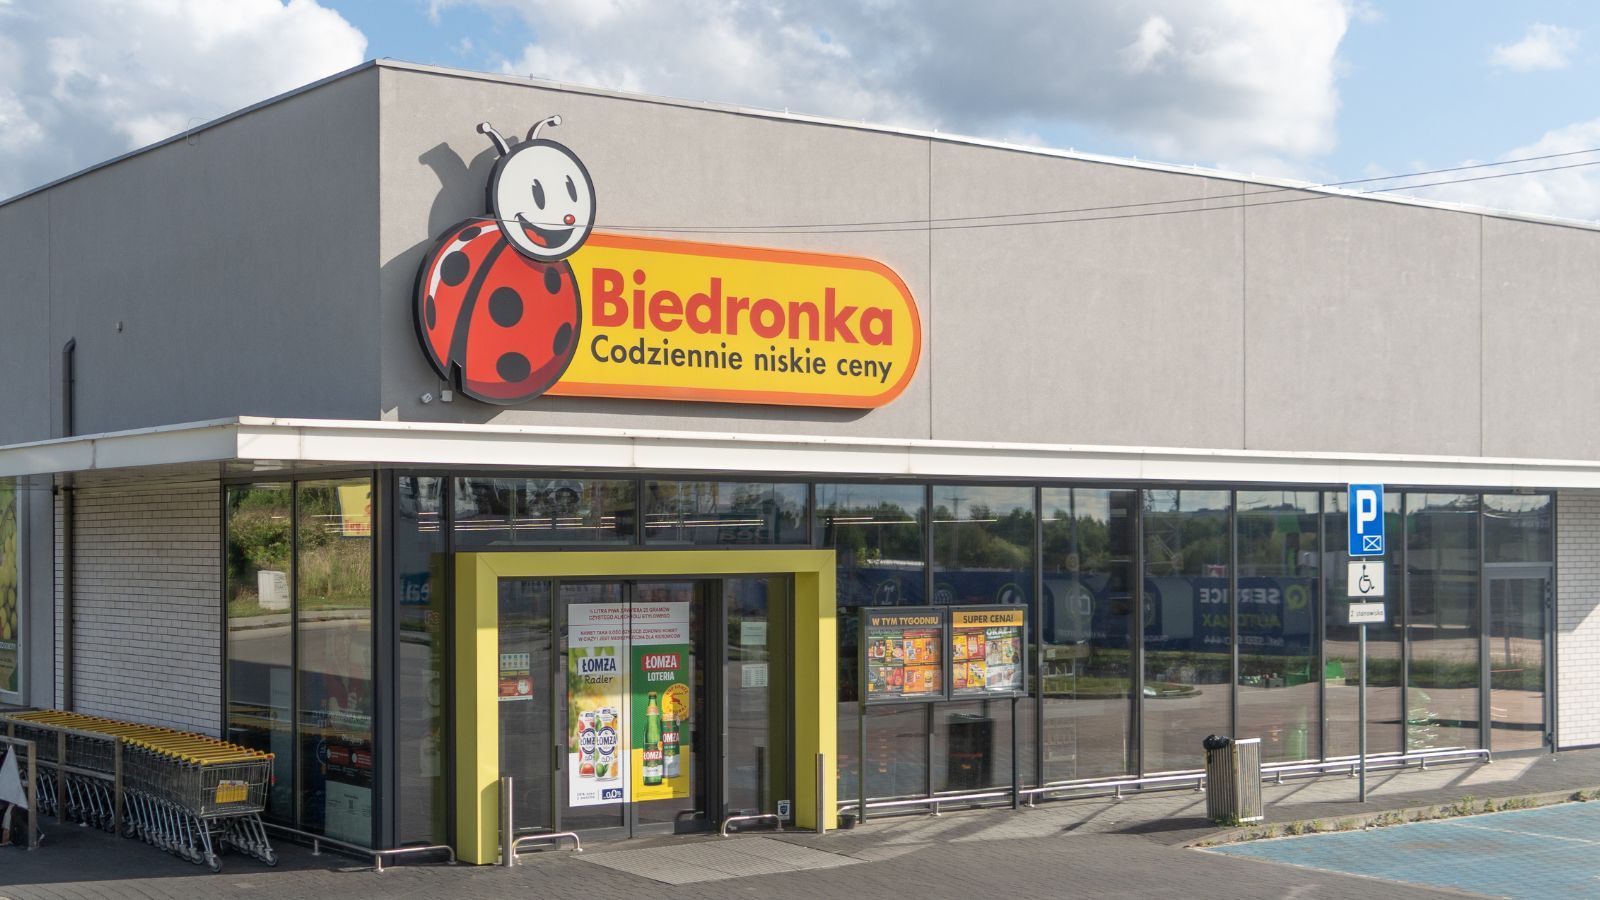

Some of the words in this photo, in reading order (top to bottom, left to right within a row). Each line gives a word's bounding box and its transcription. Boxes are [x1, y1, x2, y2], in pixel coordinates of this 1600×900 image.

[591, 267, 893, 346] Biedronka
[591, 334, 743, 370] Codziennie
[754, 345, 826, 375] niskie
[836, 357, 893, 384] ceny
[1356, 489, 1377, 534] P
[872, 618, 880, 626] W
[882, 617, 898, 625] TYM
[899, 616, 939, 625] TYGODNIU
[963, 615, 988, 624] SUPER
[990, 614, 1014, 623] CENA!
[584, 674, 613, 685] Radler
[647, 670, 675, 681] LOTERIA
